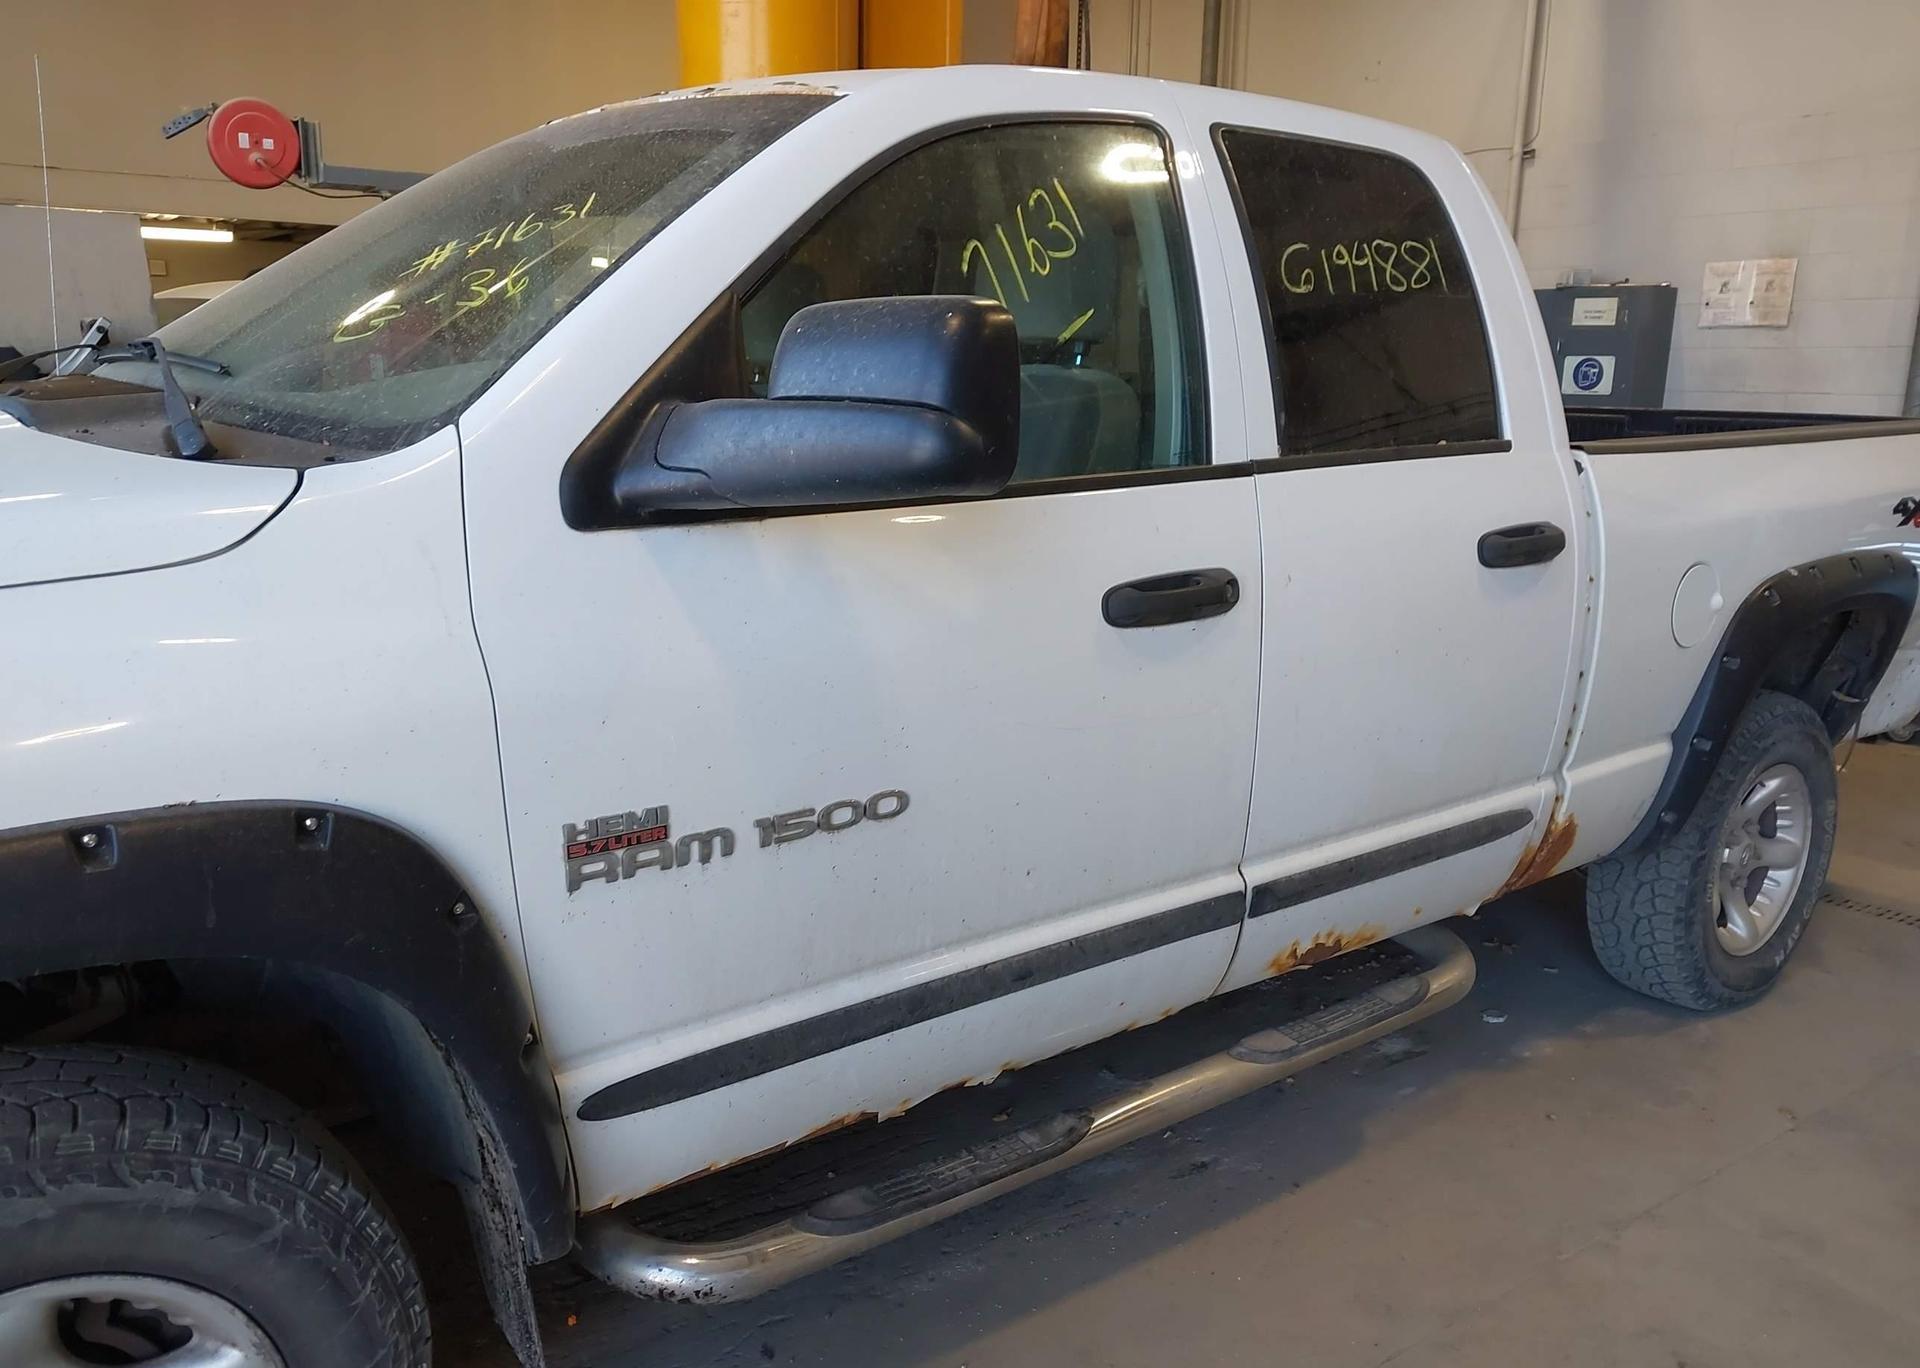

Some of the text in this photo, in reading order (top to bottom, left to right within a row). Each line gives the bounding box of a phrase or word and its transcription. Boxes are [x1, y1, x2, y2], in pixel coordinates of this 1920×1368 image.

[960, 176, 1084, 309] 71631
[562, 804, 669, 844] HEMI
[564, 788, 911, 893] RAM 1500
